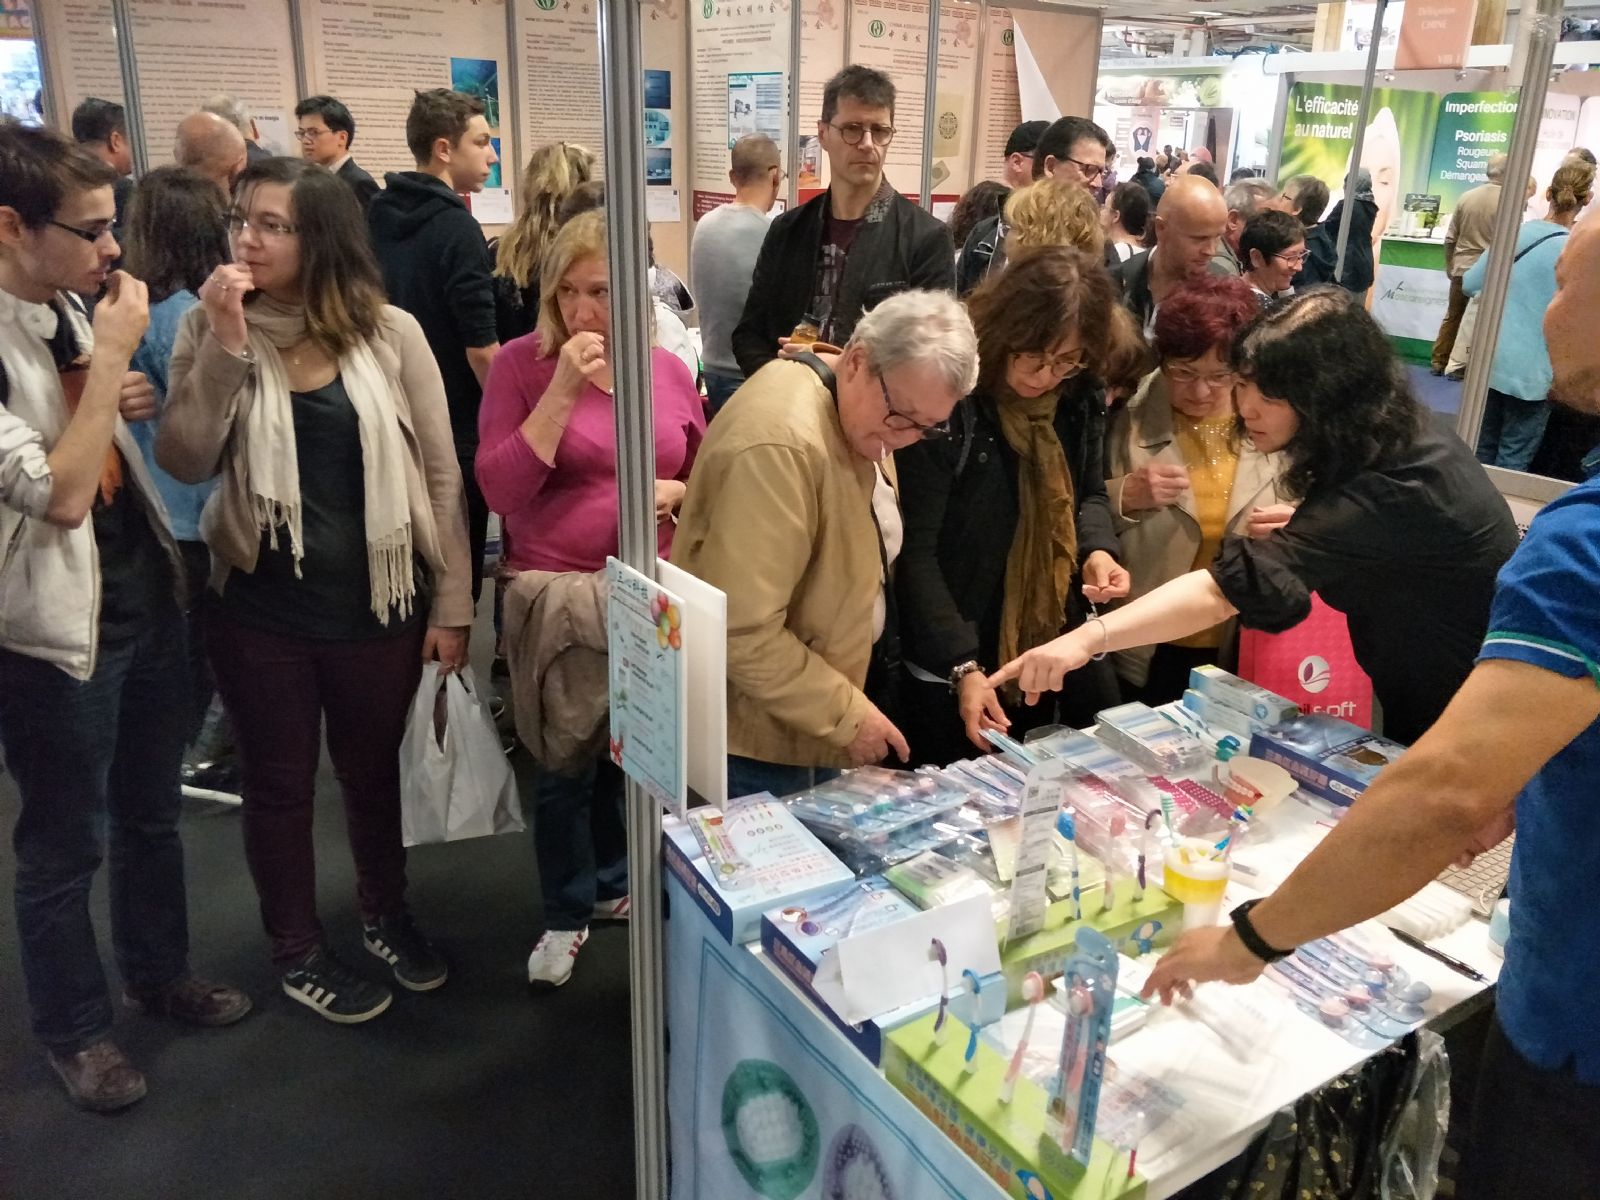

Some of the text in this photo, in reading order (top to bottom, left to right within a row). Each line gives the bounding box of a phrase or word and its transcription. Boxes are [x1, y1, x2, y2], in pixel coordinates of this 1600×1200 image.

[1296, 95, 1359, 116] L'efficacité
[1543, 108, 1575, 121] NOVATION
[1295, 122, 1353, 139] au naturel
[1455, 130, 1507, 143] Psoriasis
[1456, 158, 1488, 170] Squam
[1440, 170, 1489, 183] Démangea
